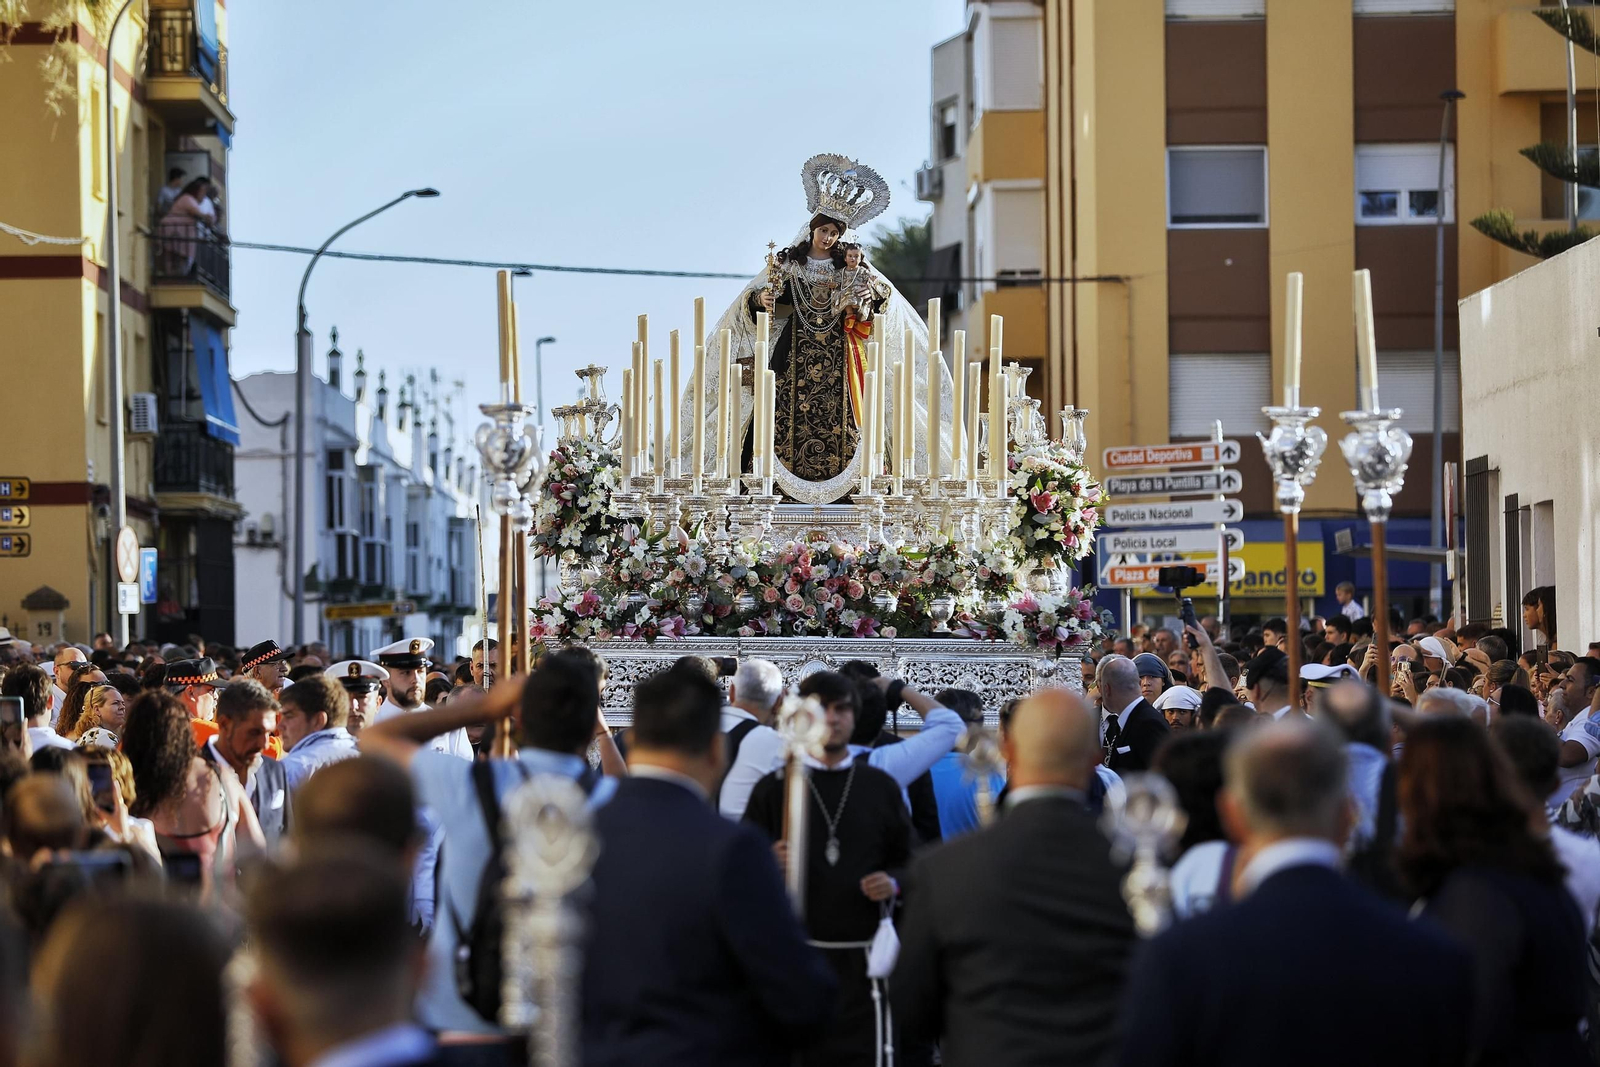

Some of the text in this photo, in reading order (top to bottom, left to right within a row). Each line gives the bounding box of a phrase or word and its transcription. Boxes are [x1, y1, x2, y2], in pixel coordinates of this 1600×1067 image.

[1110, 448, 1193, 464] Ciudad Deportiva
[1111, 476, 1200, 494] Playa de la Puntilla
[1149, 507, 1193, 520] Nacional
[1150, 536, 1177, 549] Local
[1114, 567, 1160, 582] Plaza de
